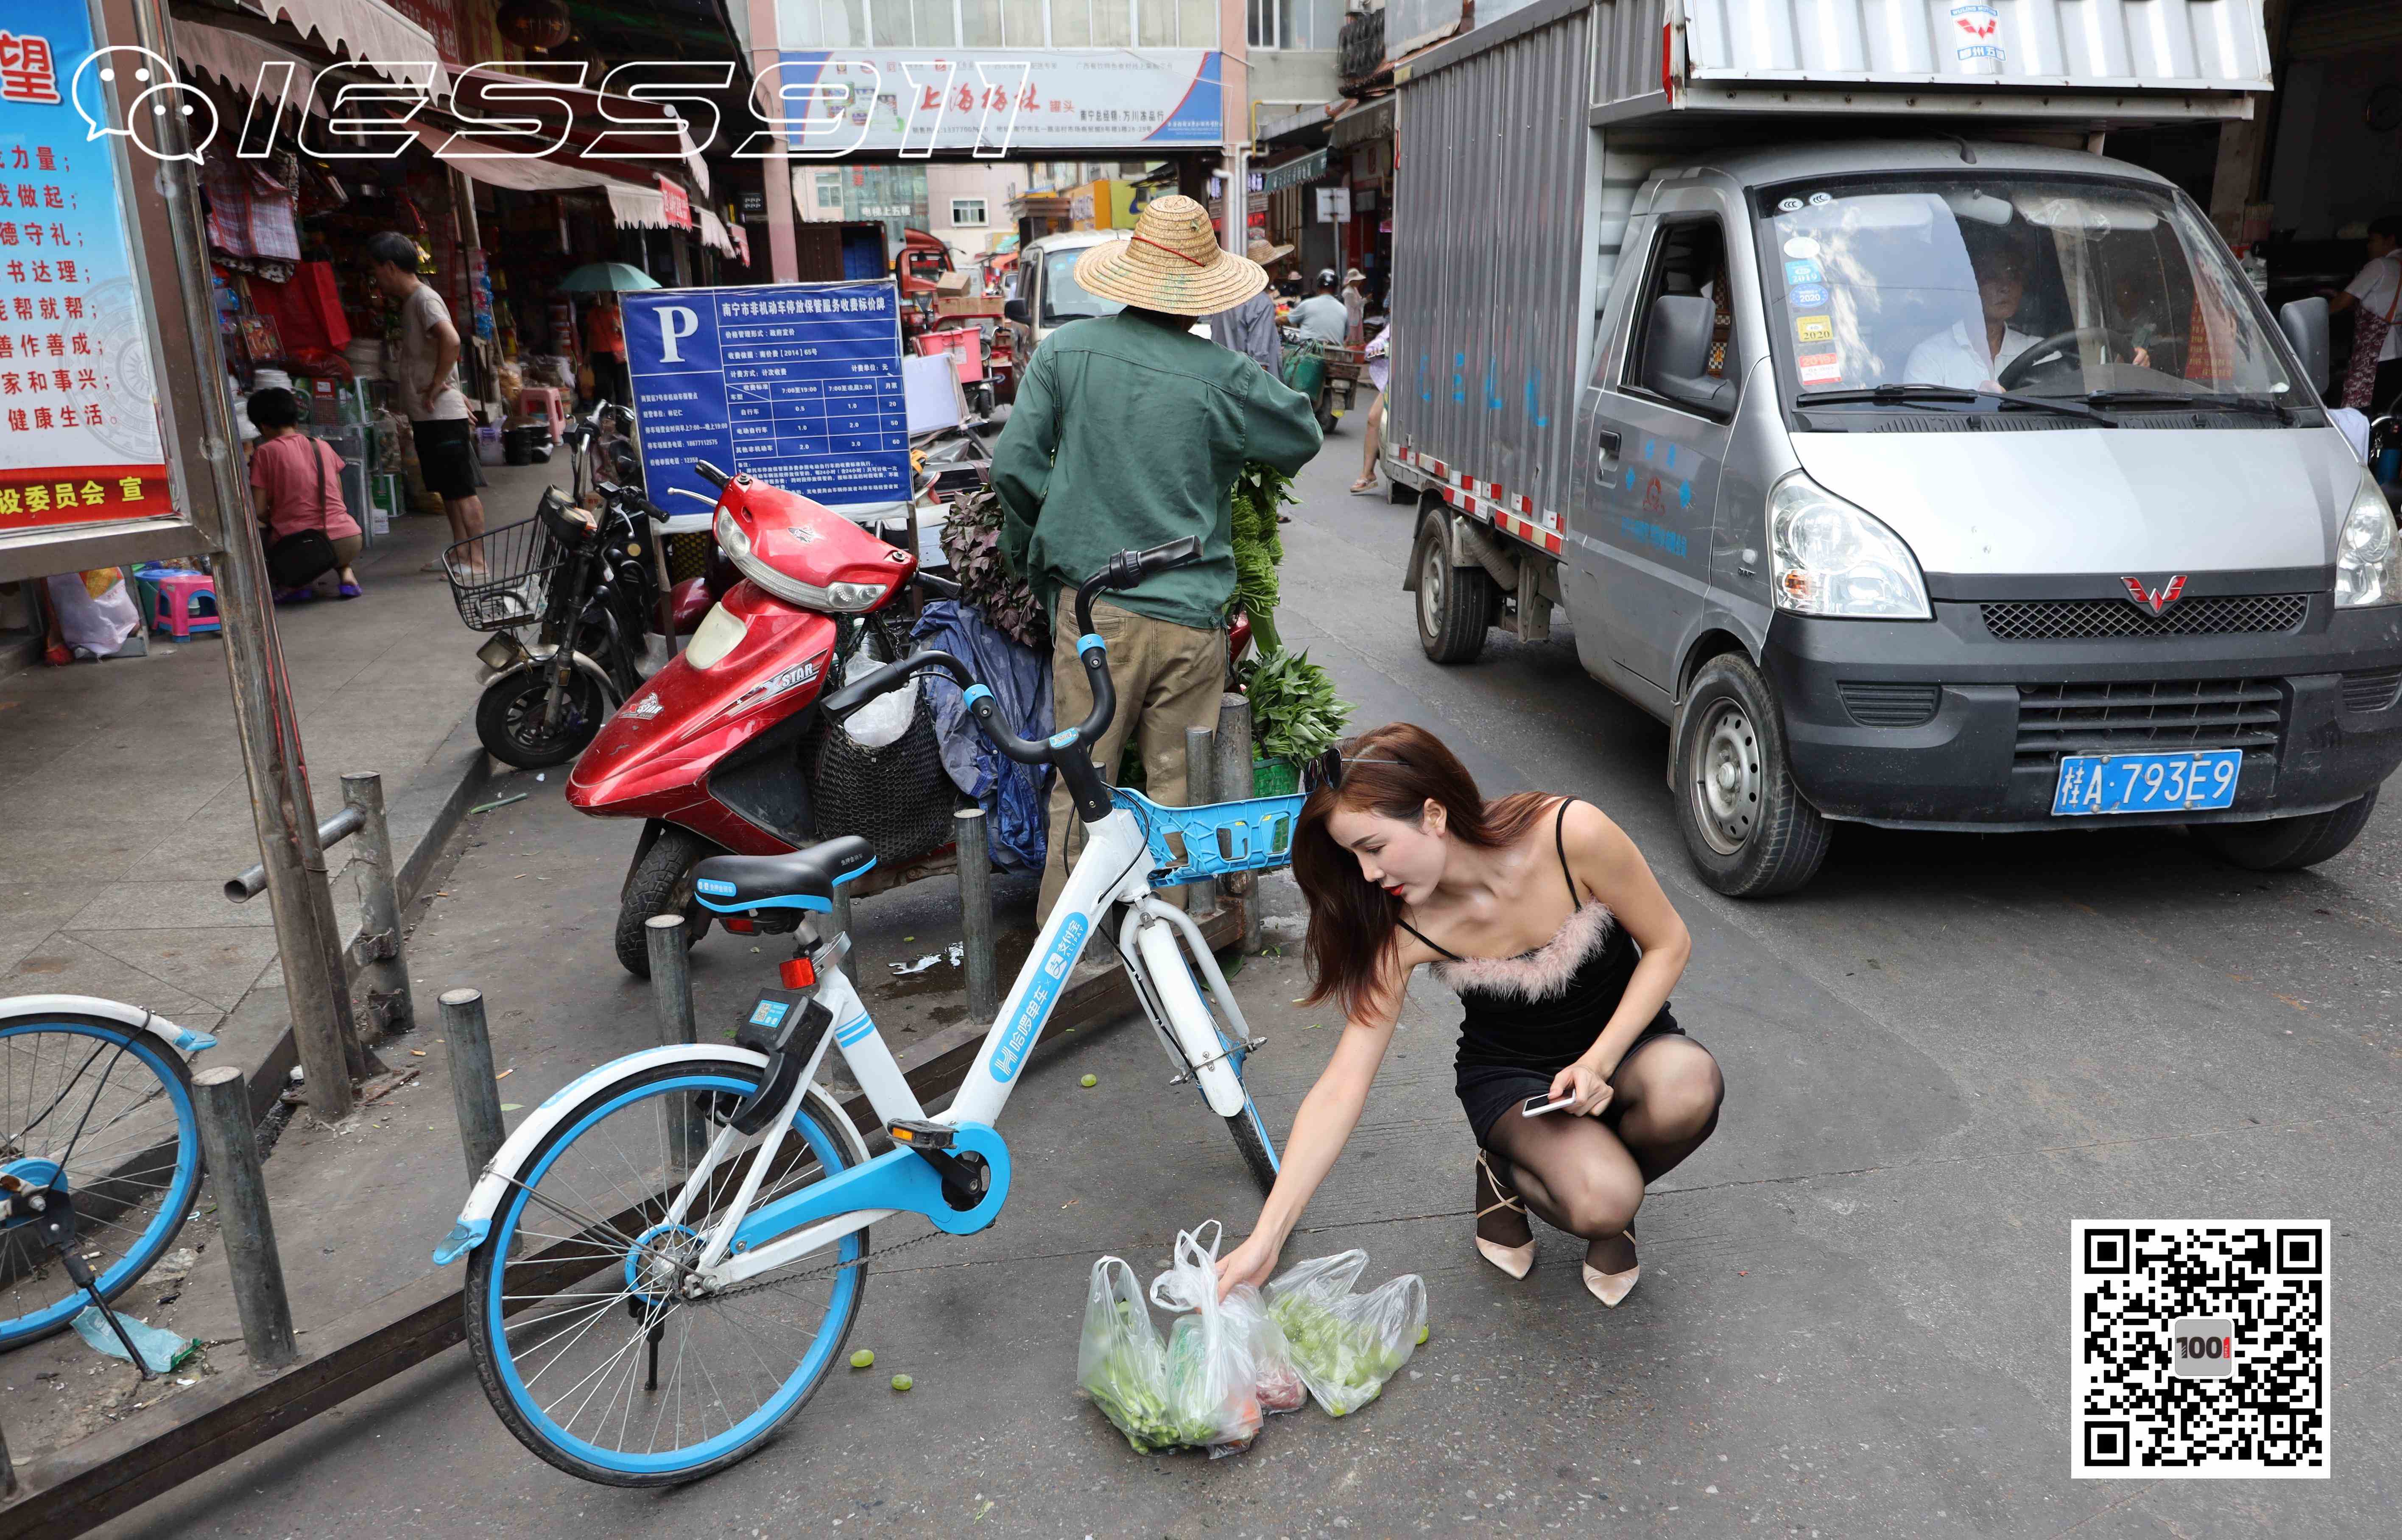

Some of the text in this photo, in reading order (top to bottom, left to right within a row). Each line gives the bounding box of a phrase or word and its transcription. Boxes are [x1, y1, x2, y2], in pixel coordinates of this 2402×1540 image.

[722, 297, 885, 317] 南宁市非机动车停放保管服务收费标价牌
[1799, 293, 1821, 303] 2020
[652, 306, 699, 363] P
[1804, 330, 1830, 340] 2020
[737, 426, 768, 435] 电动自行车
[119, 476, 145, 502] 宣
[1067, 927, 1084, 957] ALIPAY
